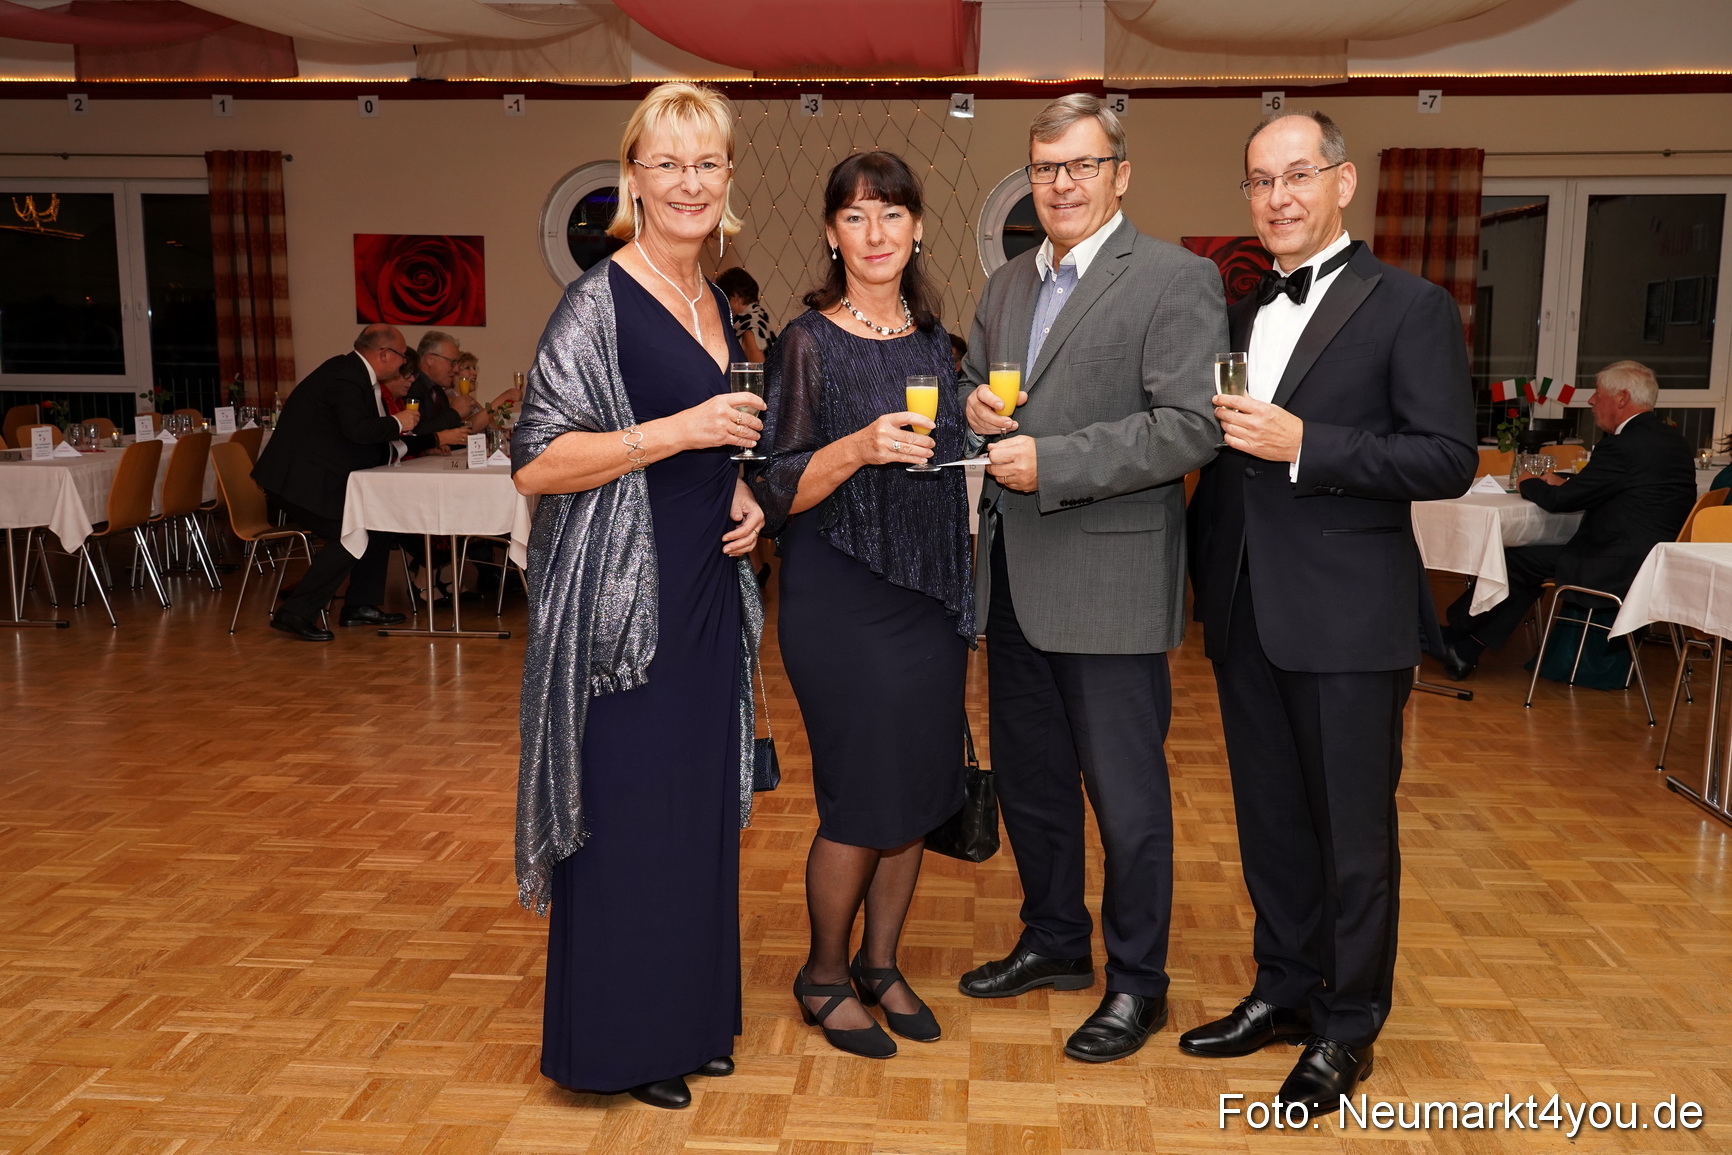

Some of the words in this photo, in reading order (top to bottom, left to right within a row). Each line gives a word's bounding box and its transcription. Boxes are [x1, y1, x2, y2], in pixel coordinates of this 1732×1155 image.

[74, 98, 83, 112] 2
[219, 99, 226, 113] 1
[365, 100, 373, 113] 0
[508, 99, 520, 112] -1
[805, 99, 819, 112] -3
[955, 98, 970, 112] -4
[1110, 98, 1125, 112] -5
[1266, 96, 1280, 110] -6
[1422, 95, 1437, 109] -7
[451, 460, 459, 469] 14
